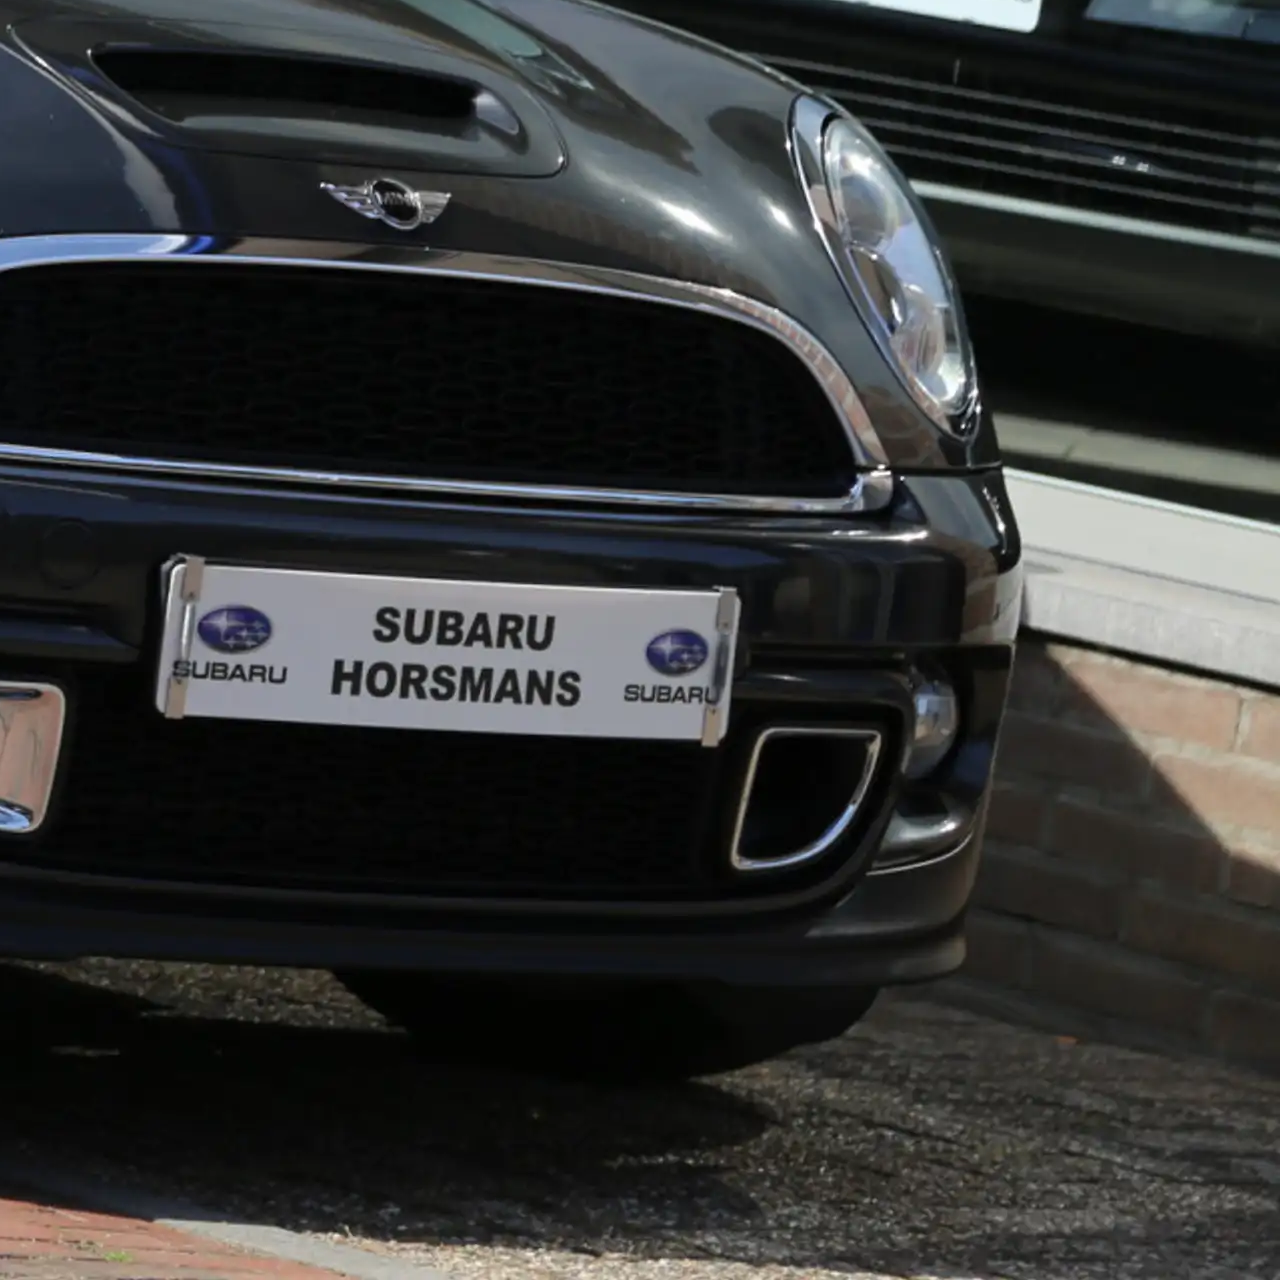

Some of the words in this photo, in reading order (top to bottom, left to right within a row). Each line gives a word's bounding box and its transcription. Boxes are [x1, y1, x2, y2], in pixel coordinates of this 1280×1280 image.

[373, 606, 557, 651] SUBARU
[171, 660, 288, 685] SUBARU
[330, 658, 582, 708] HORSMANS
[623, 684, 720, 706] SUBARU
